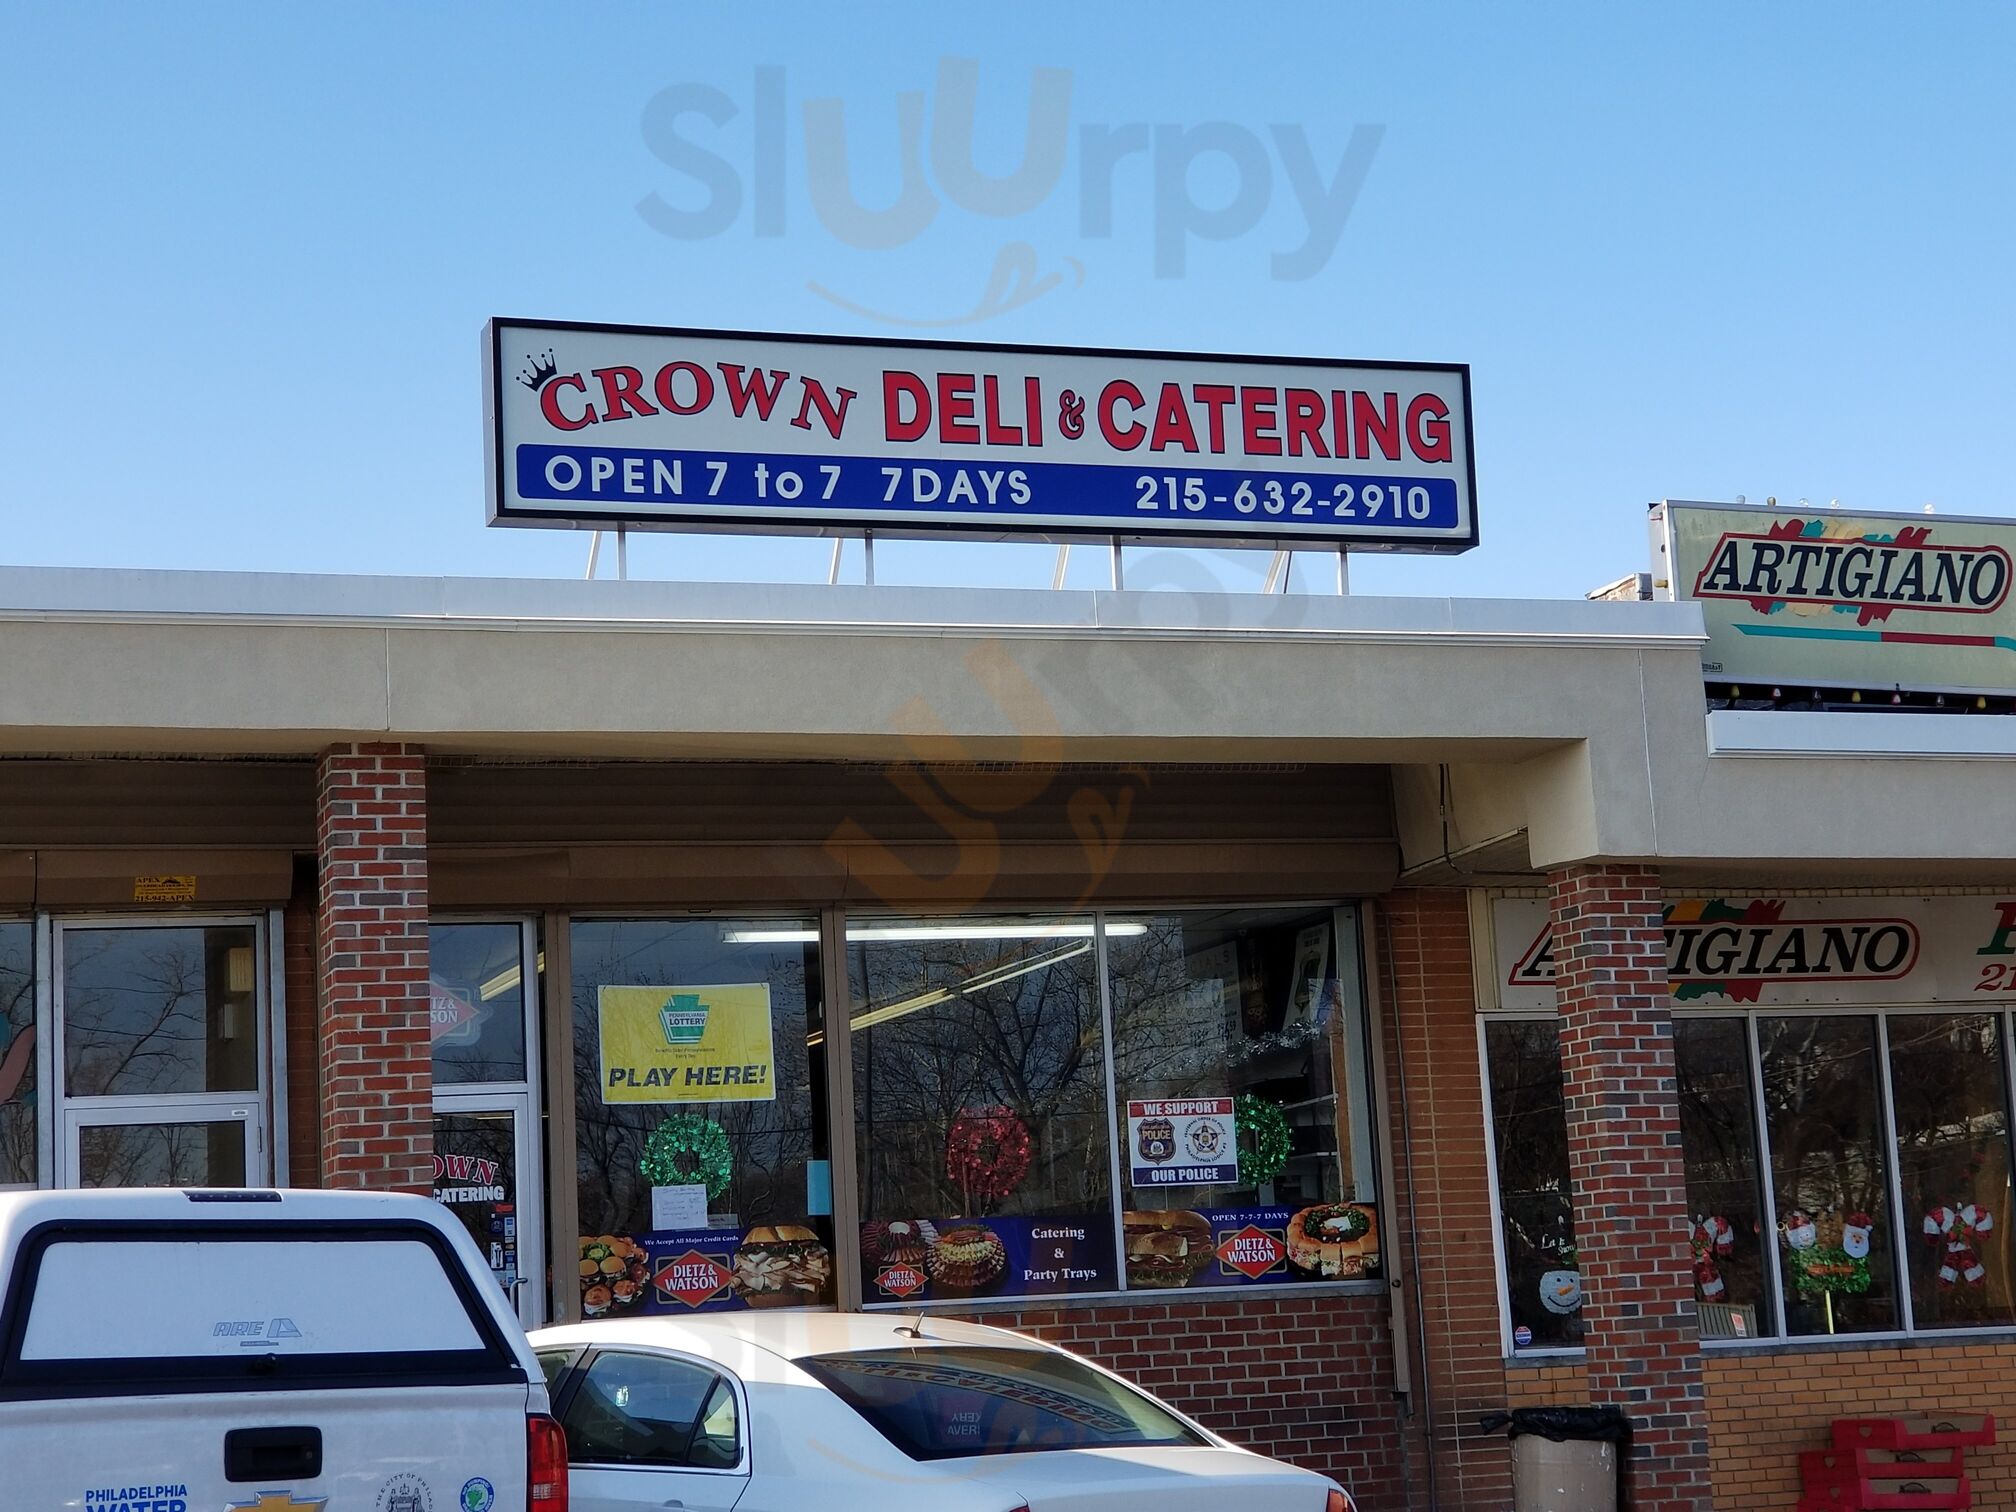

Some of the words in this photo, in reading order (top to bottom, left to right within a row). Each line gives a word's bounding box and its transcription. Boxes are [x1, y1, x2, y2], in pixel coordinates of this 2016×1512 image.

[540, 360, 858, 440] CROWN
[882, 370, 1044, 447] DELI
[1058, 389, 1086, 441] &
[1098, 379, 1454, 464] CATERING
[545, 455, 682, 496] OPEN
[705, 461, 729, 496] 7
[754, 463, 804, 500] to
[819, 466, 842, 500] 7
[1135, 475, 1432, 520] 215-632-2910
[1703, 540, 2007, 606] ARTIGIANO
[1522, 925, 1911, 977] AIGIANO
[431, 1010, 458, 1024] SON
[608, 1067, 677, 1087] PLAY
[685, 1065, 767, 1086] HERE!
[1143, 1103, 1163, 1115] WE
[1165, 1101, 1218, 1114] SUPPORT
[1142, 1129, 1171, 1140] POLICE
[1151, 1169, 1176, 1182] OUR
[1178, 1168, 1219, 1181] POLICE
[433, 1185, 505, 1203] CATERING
[1212, 1214, 1237, 1222] OPEN
[1264, 1212, 1289, 1220] DAYS
[1031, 1227, 1086, 1240] Catering
[1234, 1238, 1264, 1250] DIETZ
[1265, 1238, 1275, 1249] &
[1054, 1247, 1065, 1258] &
[1226, 1250, 1276, 1263] WATSON
[673, 1263, 707, 1278] DIETZ
[707, 1264, 718, 1276] &
[888, 1271, 909, 1279] DIETZ
[1023, 1269, 1058, 1282] Party
[1061, 1268, 1097, 1281] Trays
[665, 1276, 718, 1292] WATSON
[884, 1278, 917, 1287] WATSON
[213, 1321, 264, 1336] ARE
[85, 1484, 187, 1503] PHILADELPHIA
